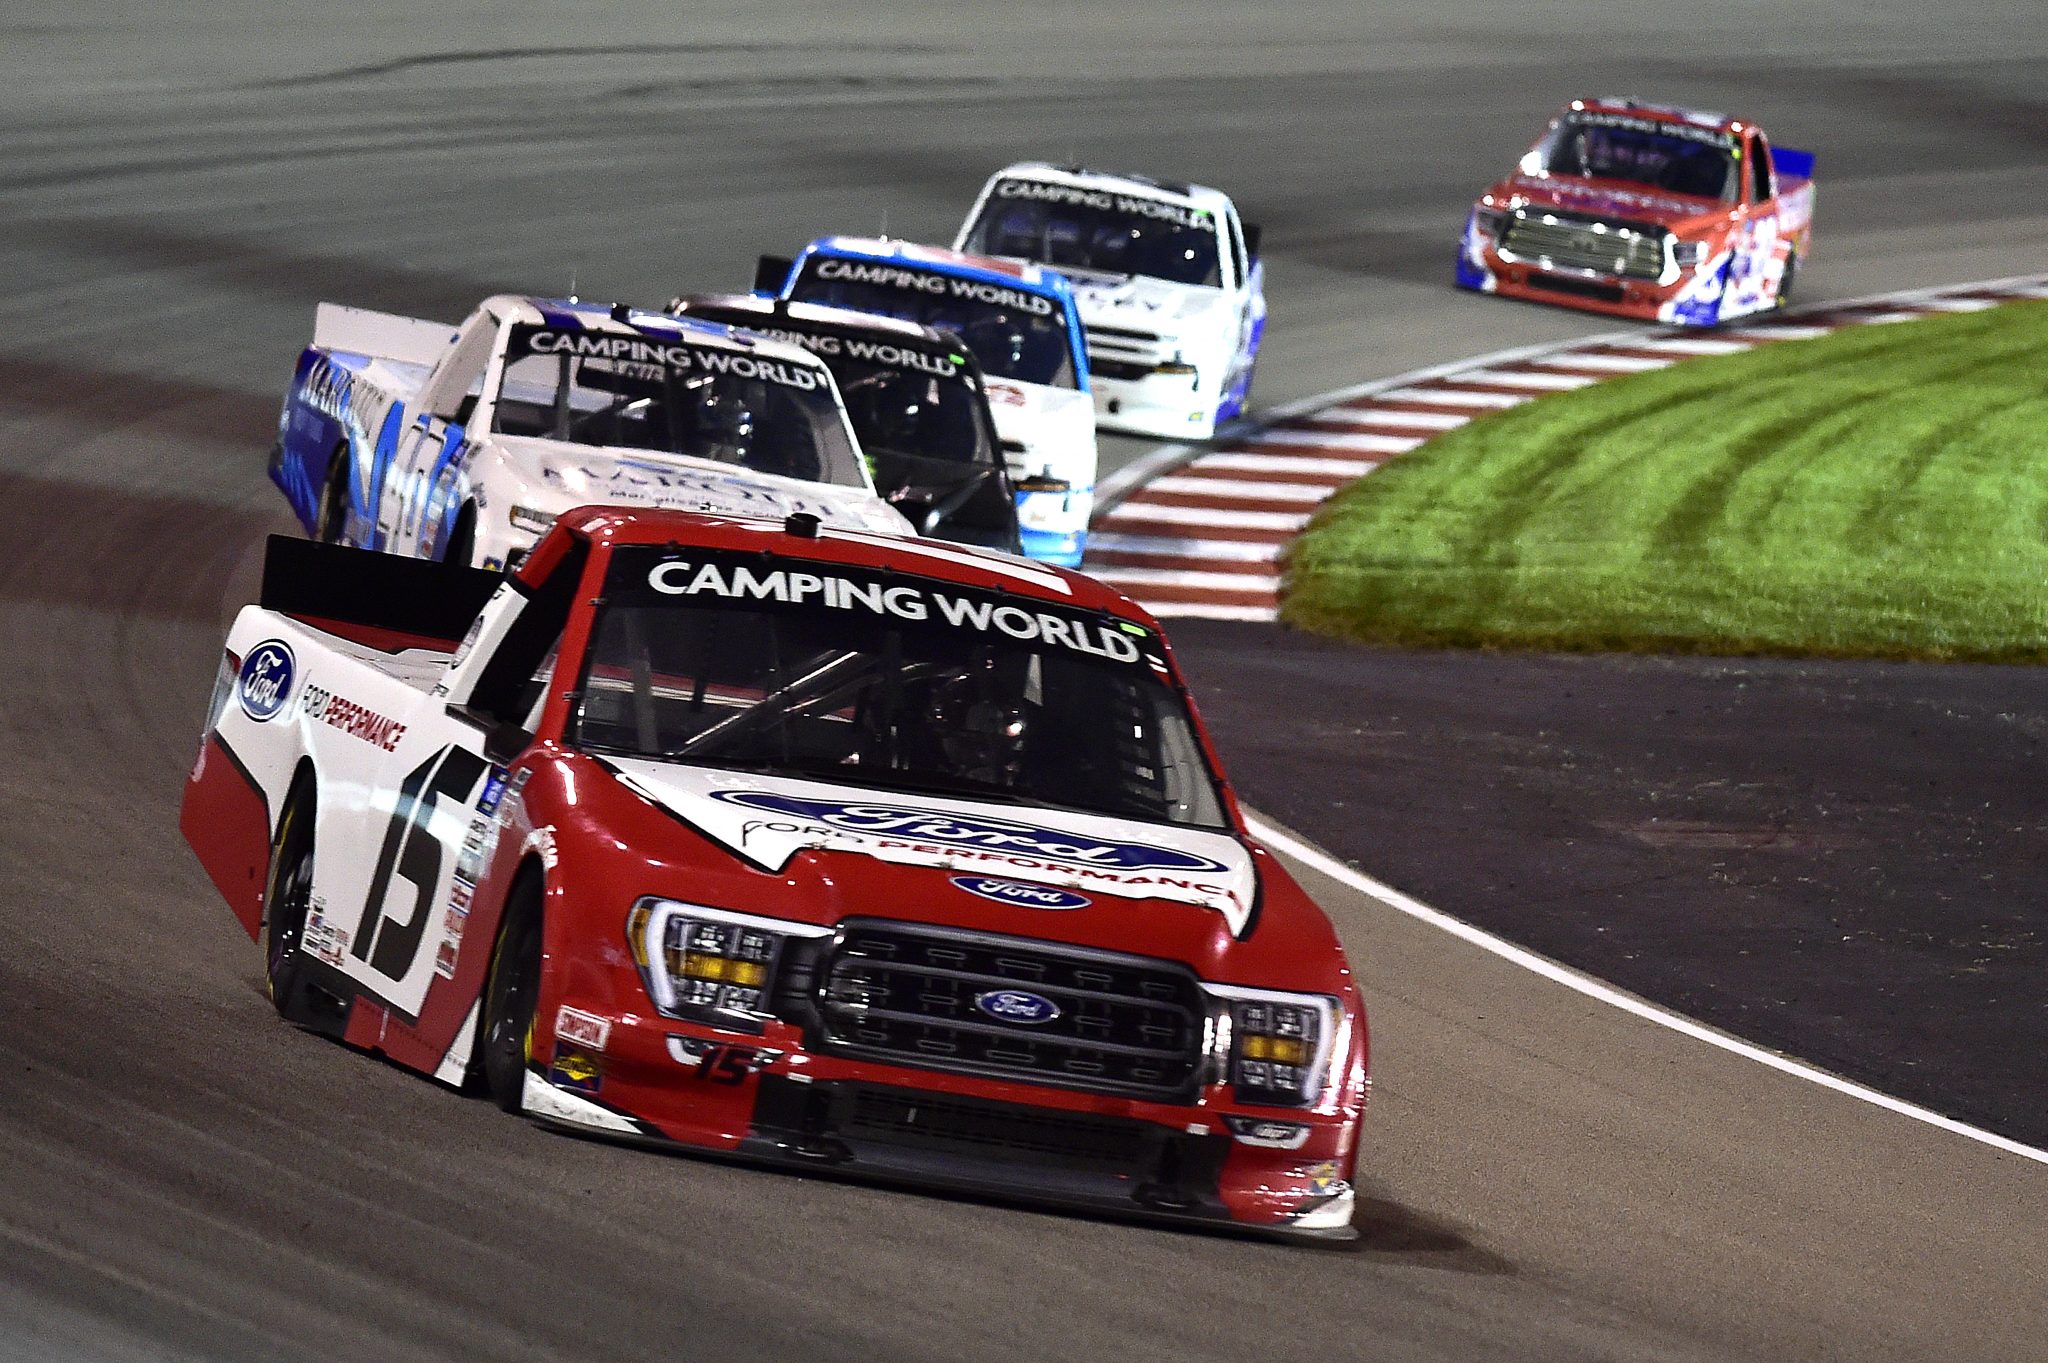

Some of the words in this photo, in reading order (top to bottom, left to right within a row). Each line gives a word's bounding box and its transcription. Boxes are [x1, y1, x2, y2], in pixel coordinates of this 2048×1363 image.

[816, 260, 947, 294] CAMPING
[950, 279, 1052, 315] WORLD
[529, 337, 692, 369] CAMPING
[695, 350, 817, 391] WORLD
[845, 339, 957, 377] WORLD
[648, 562, 928, 621] CAMPING
[934, 593, 1141, 664] WORLD
[243, 650, 287, 709] Ford
[325, 695, 408, 753] PERFORMANCE
[351, 743, 491, 982] 15
[822, 806, 1122, 864] Ford
[977, 880, 1064, 903] Ford
[992, 994, 1041, 1017] Ford
[697, 1044, 757, 1087] 15
